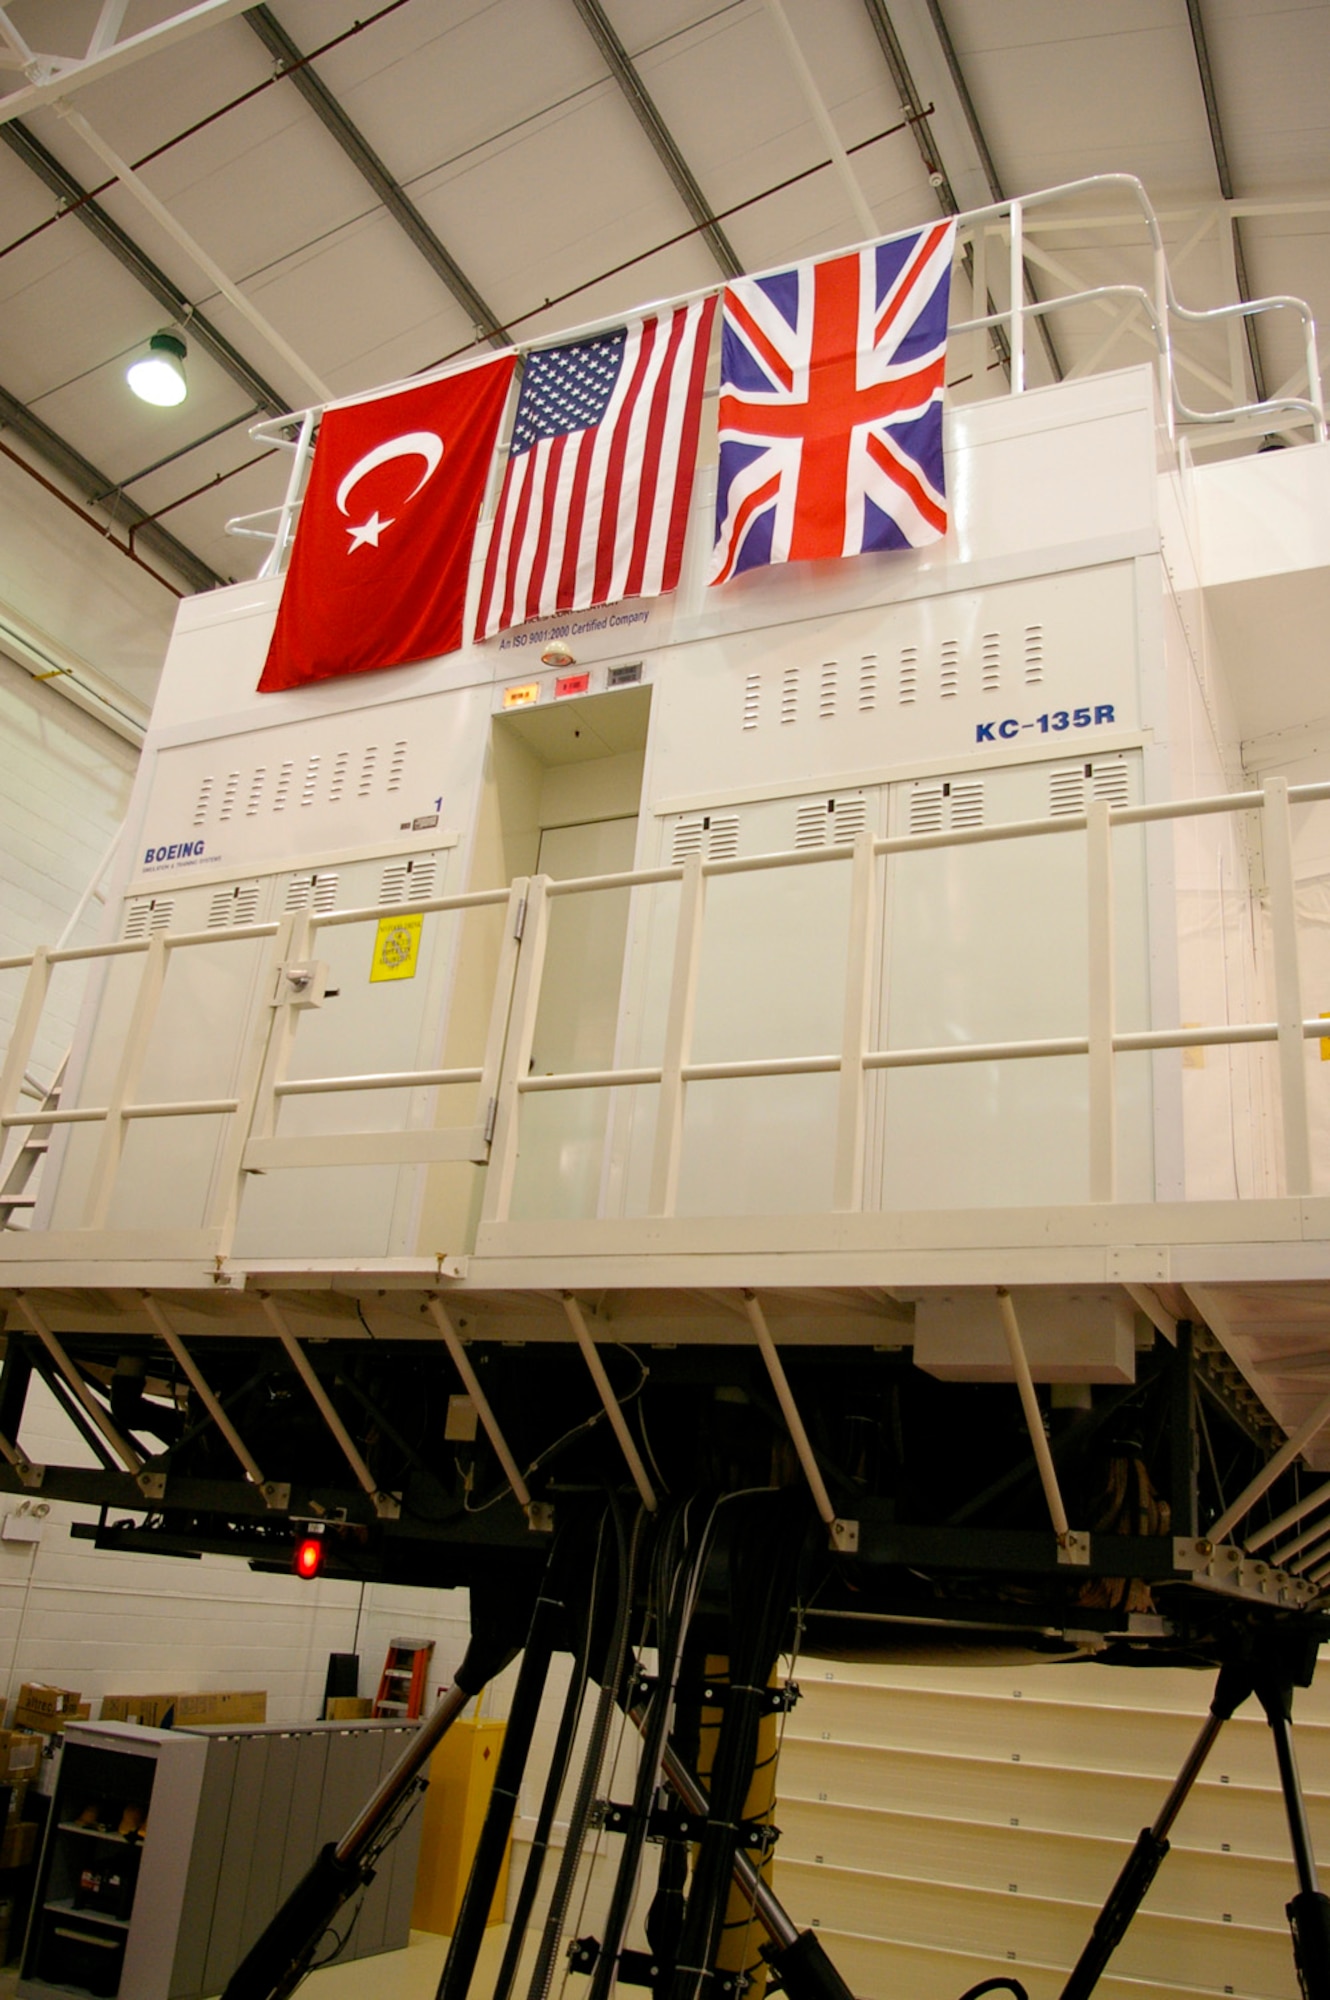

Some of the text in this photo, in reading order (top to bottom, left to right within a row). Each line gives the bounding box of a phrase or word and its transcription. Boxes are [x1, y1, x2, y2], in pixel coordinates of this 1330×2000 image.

[499, 638, 511, 651] An
[512, 633, 527, 648] ISO
[529, 625, 570, 644] 9001:2000
[571, 617, 607, 636] Certified
[610, 610, 650, 628] Company
[976, 704, 1115, 743] KC-135R
[434, 796, 443, 812] 1
[144, 840, 205, 864] BOEING
